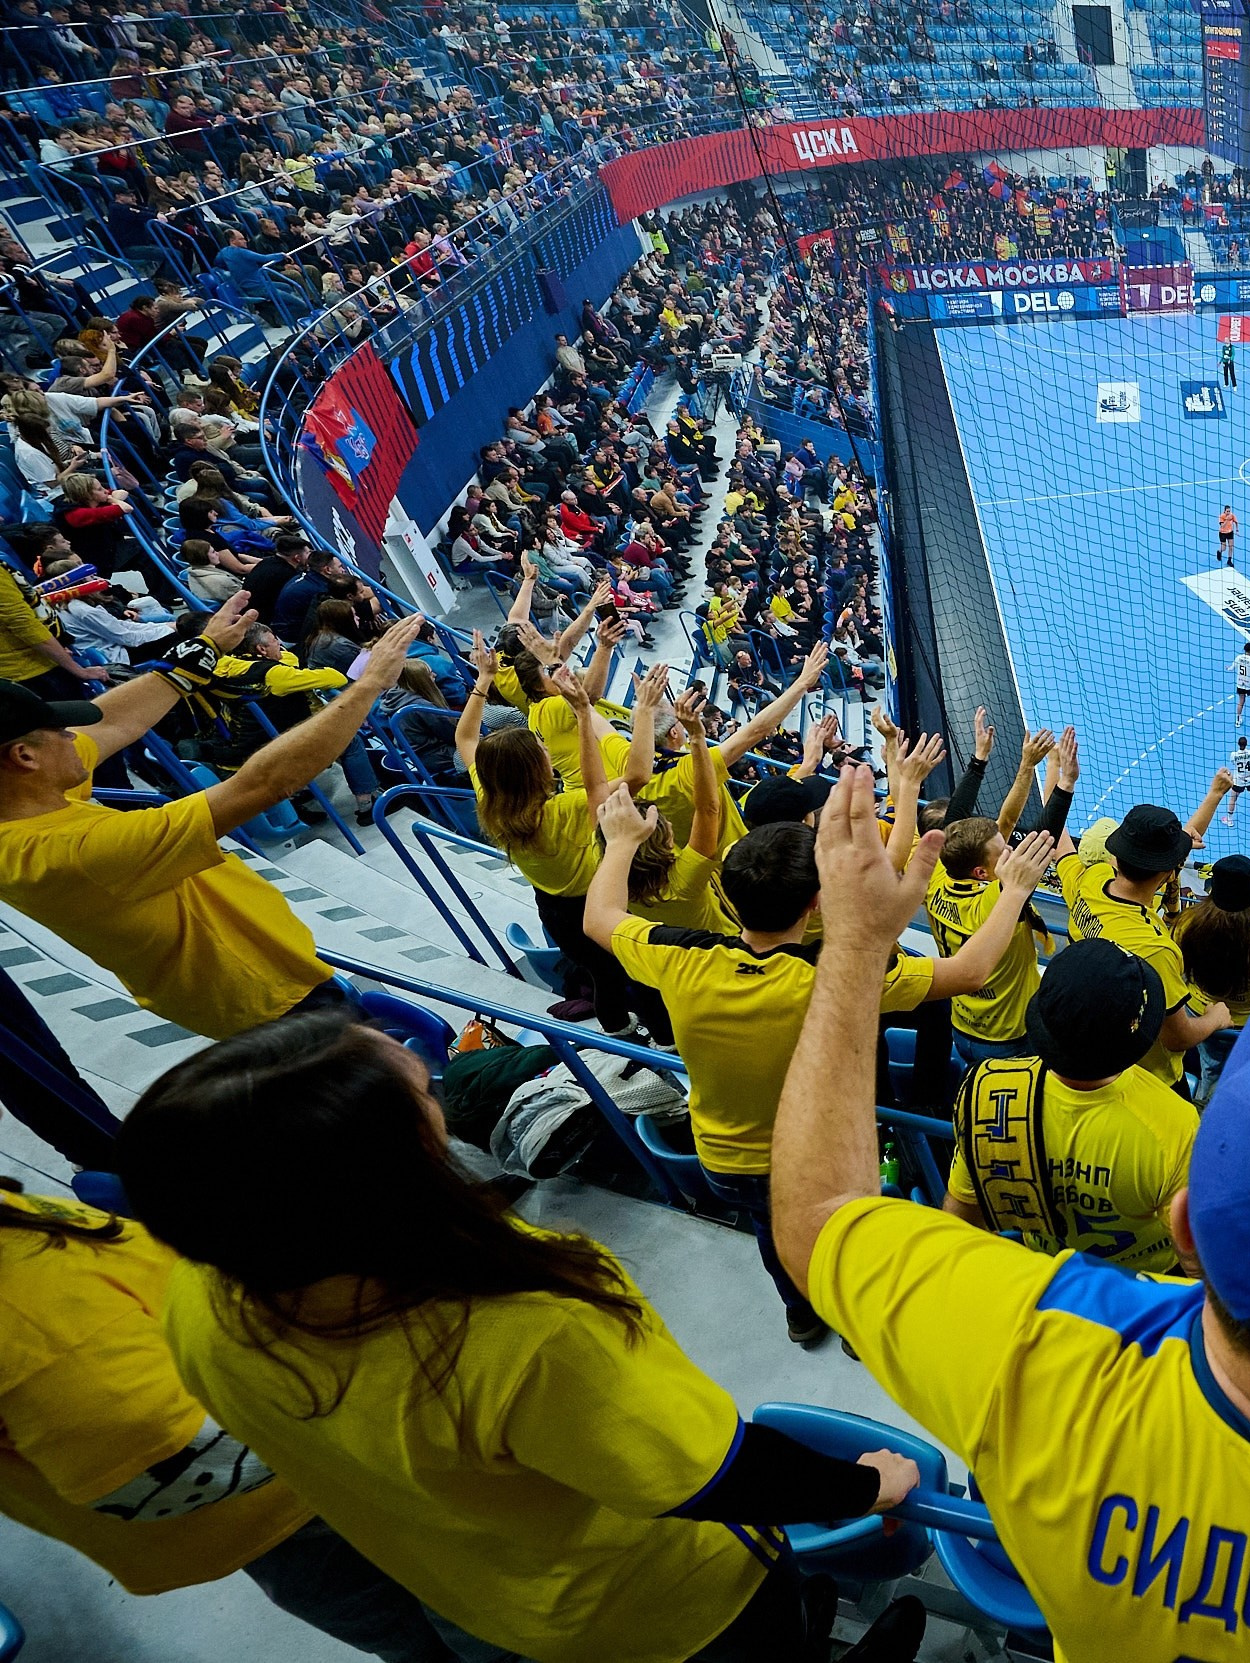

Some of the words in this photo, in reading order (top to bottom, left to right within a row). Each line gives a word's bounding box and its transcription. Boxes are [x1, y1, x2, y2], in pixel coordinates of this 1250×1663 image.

[792, 128, 858, 162] ЦСКА
[912, 269, 982, 290] ЦСКА
[985, 264, 1085, 287] МОСКВА
[1239, 665, 1247, 677] 51
[1236, 760, 1250, 773] 24
[1050, 1158, 1110, 1188] НЗНП
